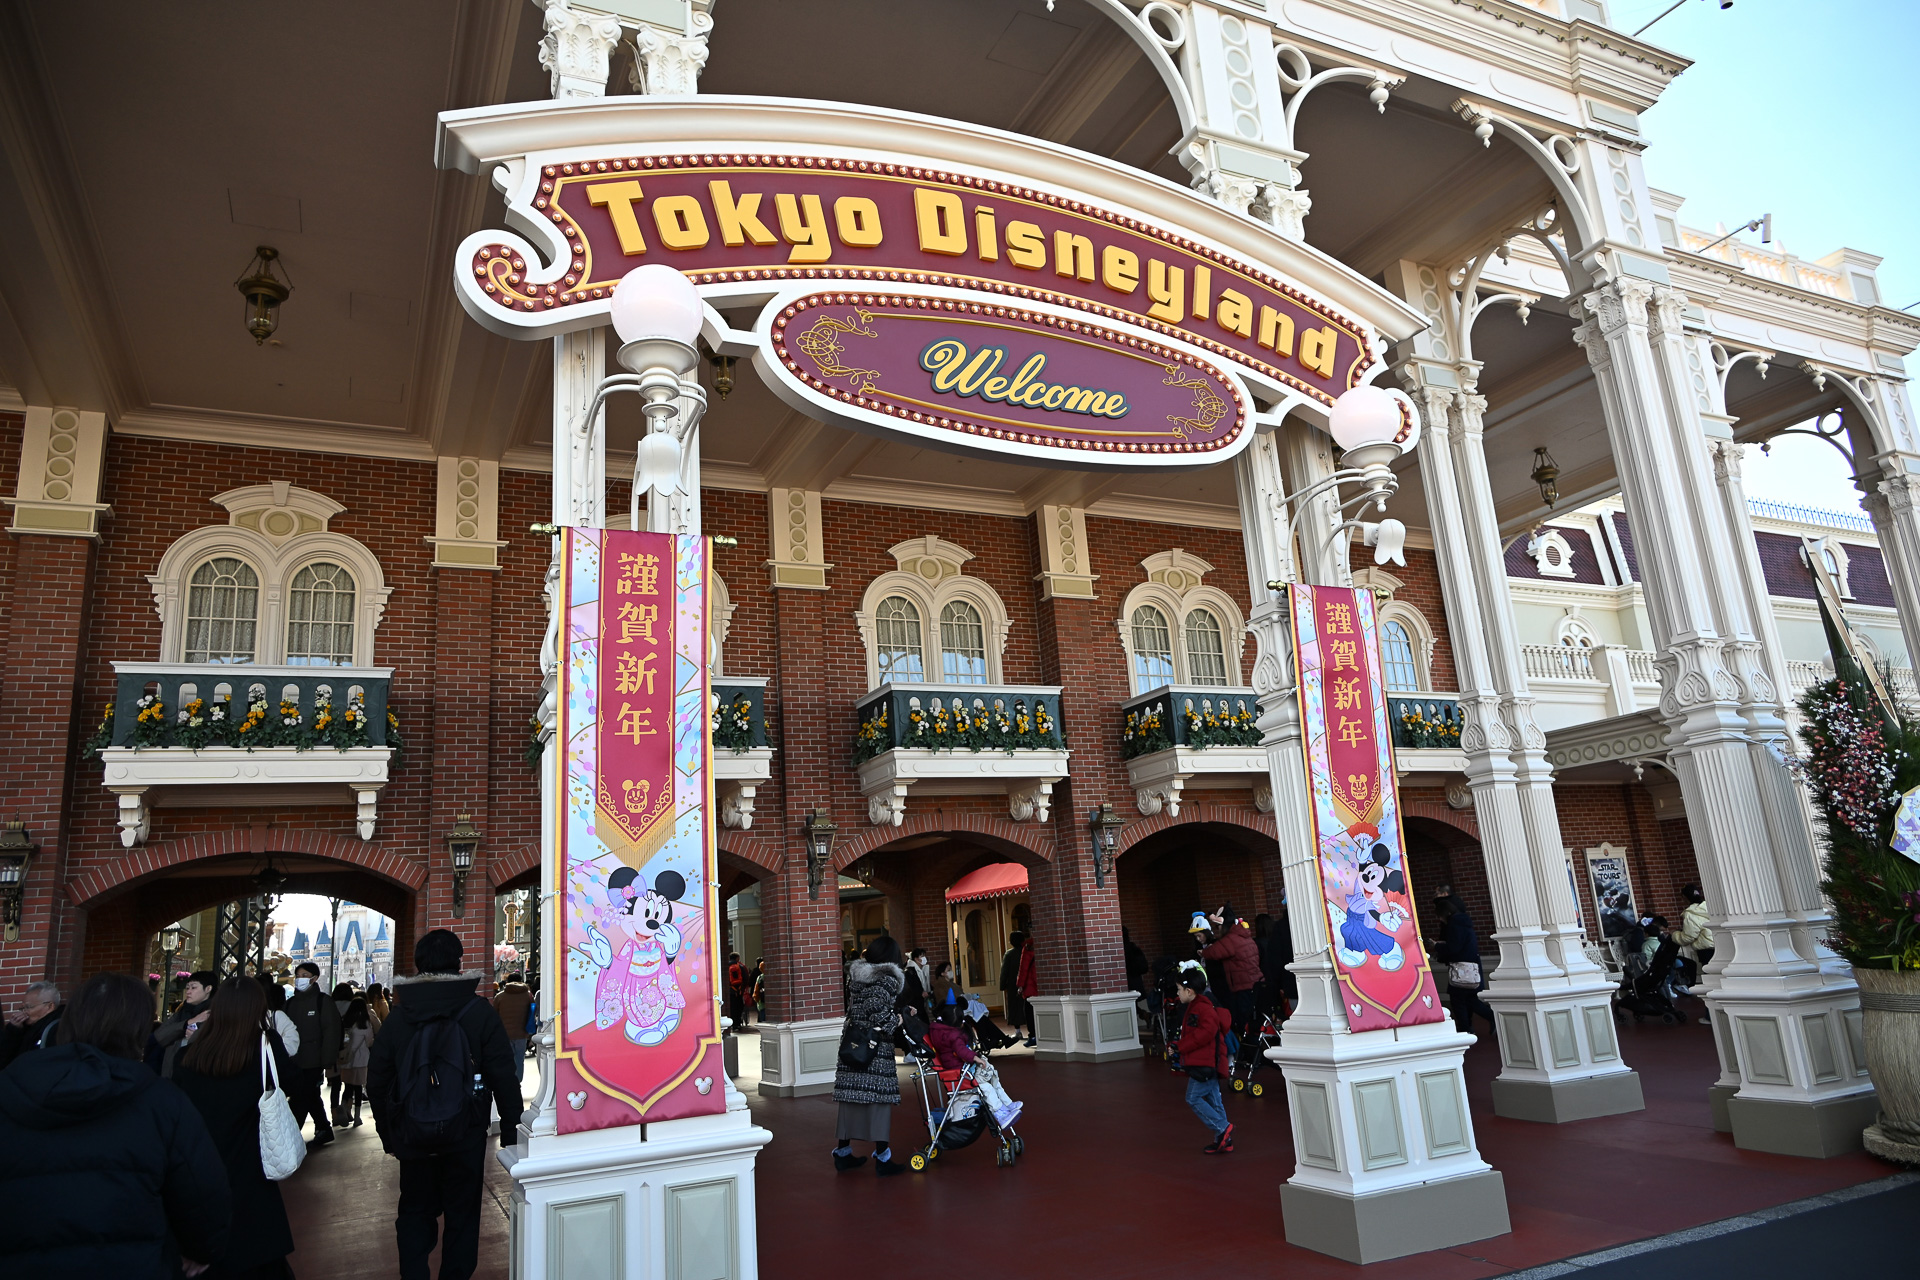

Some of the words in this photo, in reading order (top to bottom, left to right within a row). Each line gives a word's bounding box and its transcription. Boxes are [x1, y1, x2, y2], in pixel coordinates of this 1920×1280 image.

[585, 180, 884, 263] Tokyo
[913, 187, 1338, 380] Disneyland
[922, 340, 1129, 417] Welcome
[614, 552, 660, 745] 謹賀新年
[1324, 602, 1368, 748] 謹賀新年
